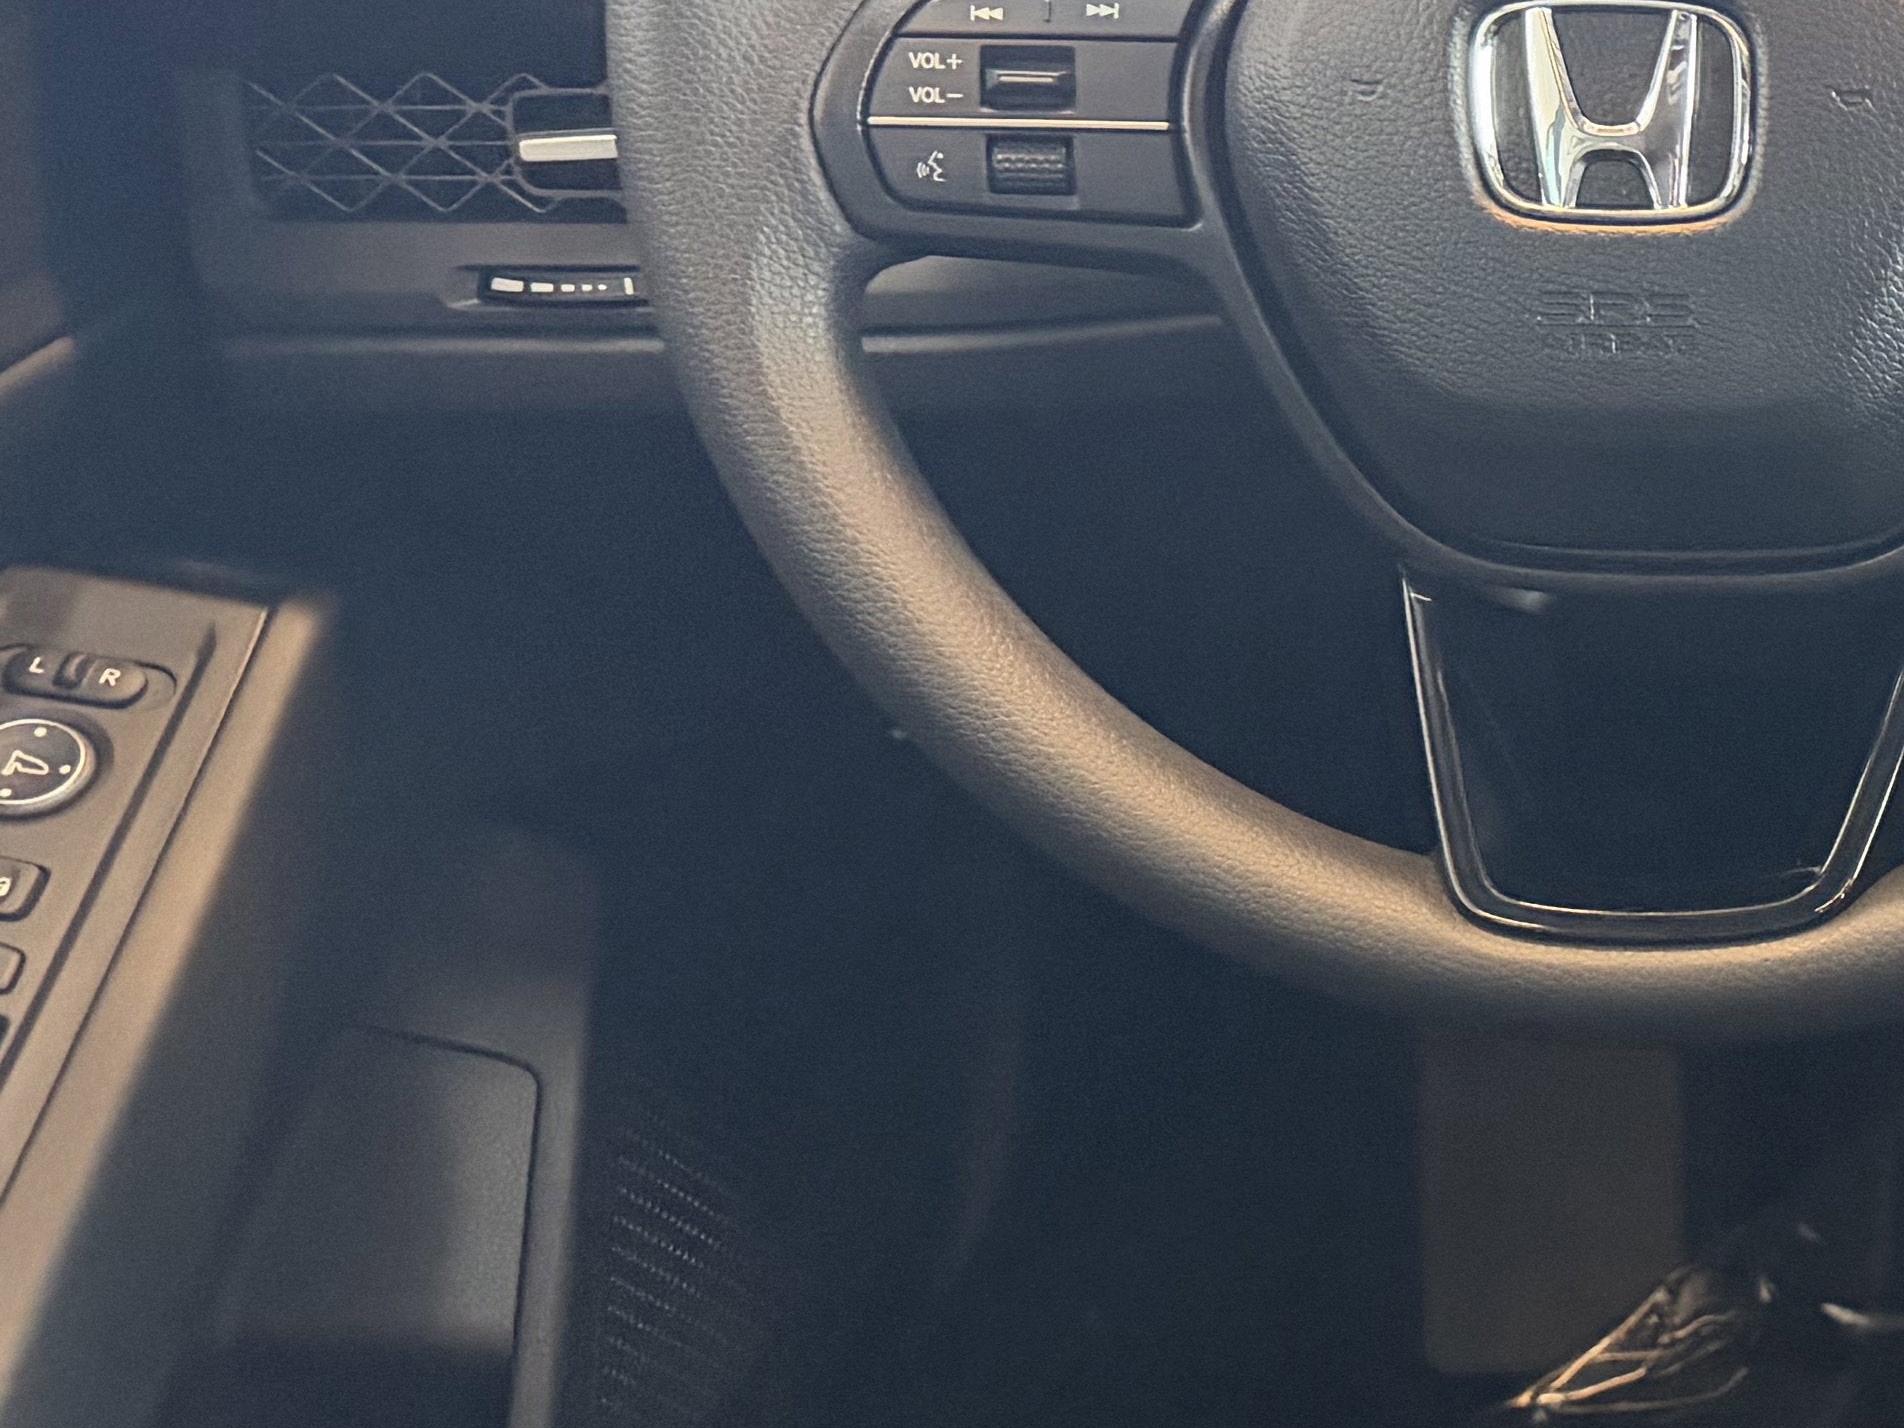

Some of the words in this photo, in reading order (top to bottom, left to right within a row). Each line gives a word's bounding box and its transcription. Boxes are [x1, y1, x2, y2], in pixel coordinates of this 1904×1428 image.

[908, 52, 963, 70] VOL+
[28, 657, 45, 674] L
[98, 668, 121, 687] R
